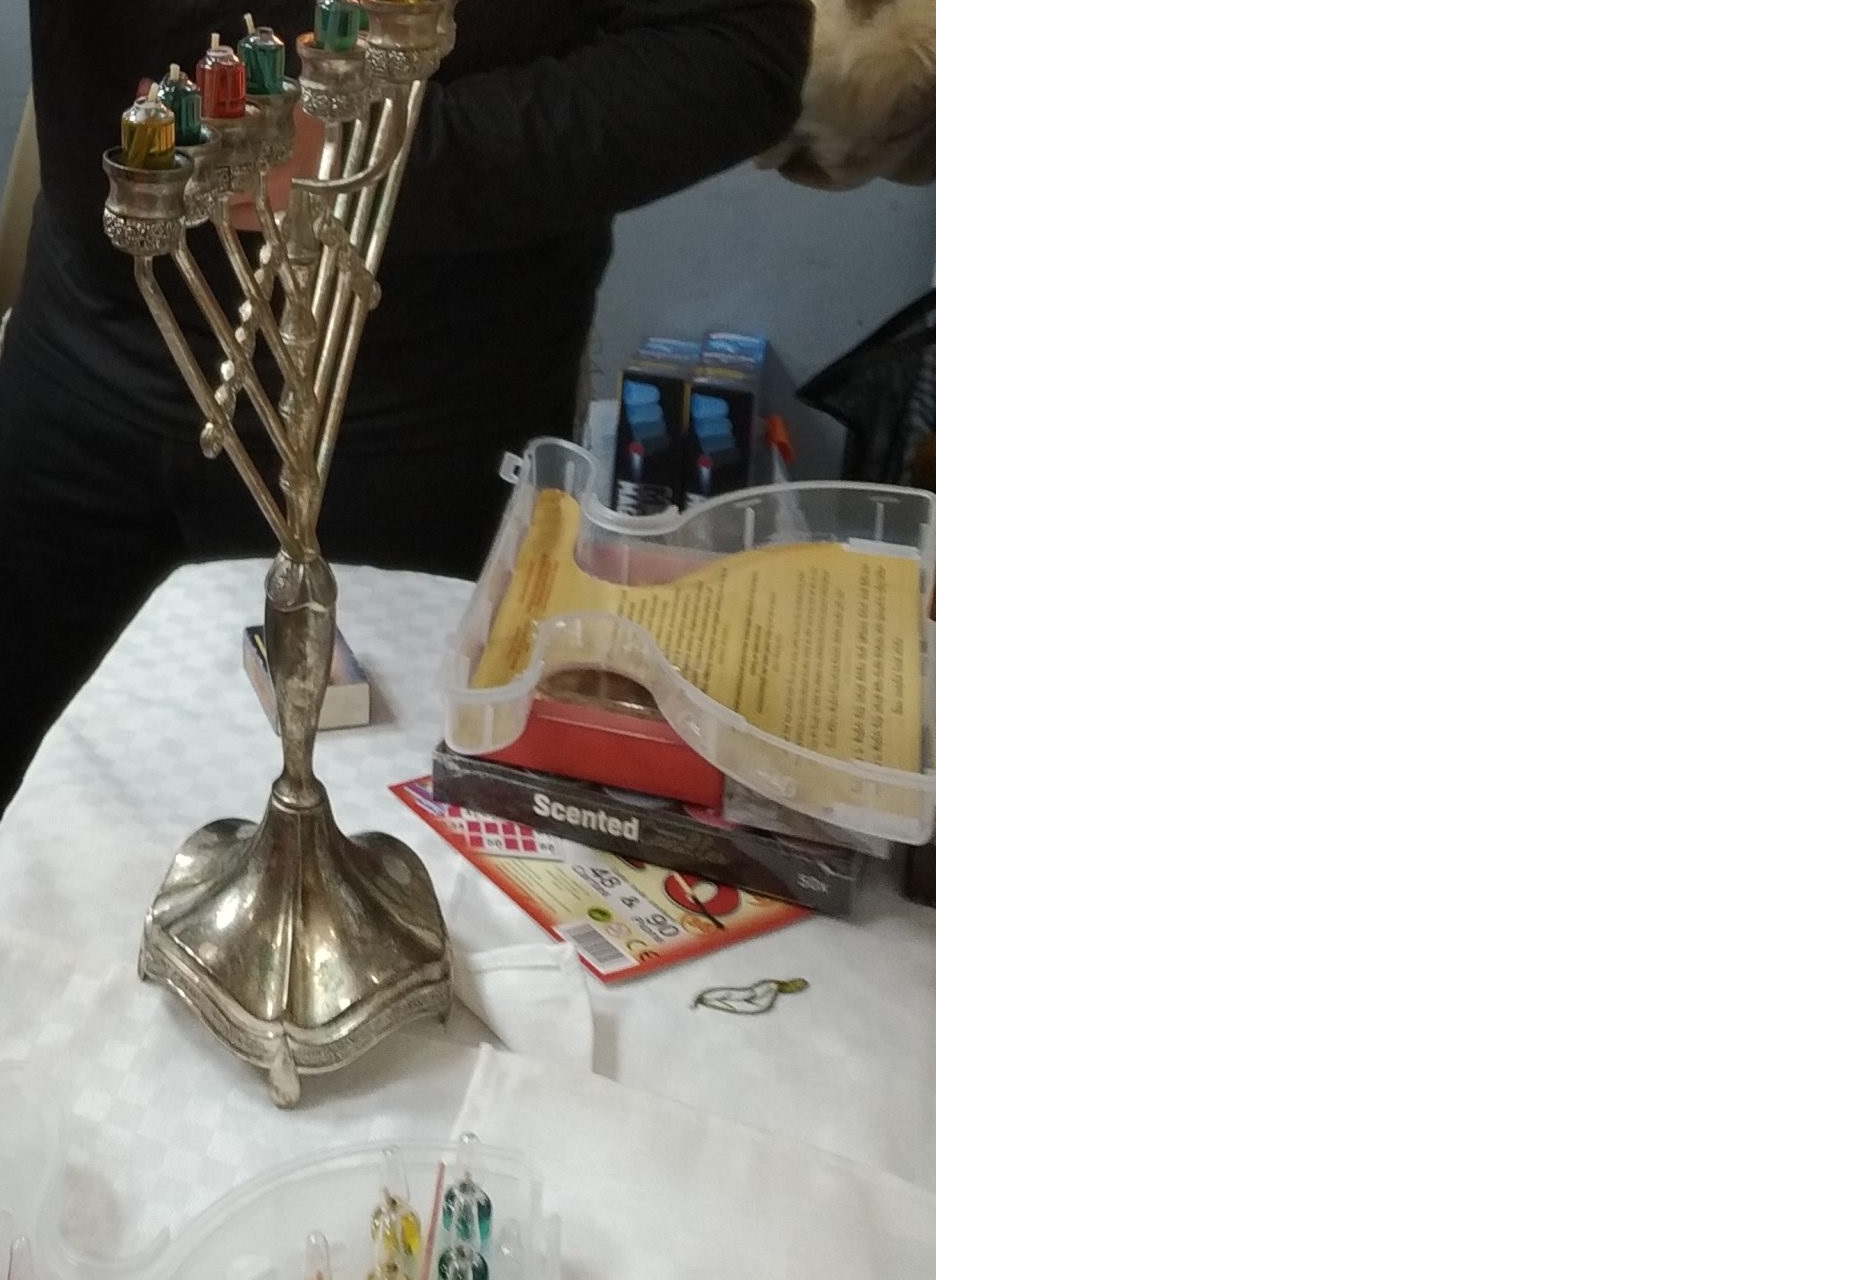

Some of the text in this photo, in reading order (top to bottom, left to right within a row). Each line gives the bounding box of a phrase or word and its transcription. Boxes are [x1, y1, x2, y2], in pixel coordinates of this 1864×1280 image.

[533, 792, 640, 842] Scented
[590, 867, 621, 889] 48
[646, 913, 680, 937] 90
